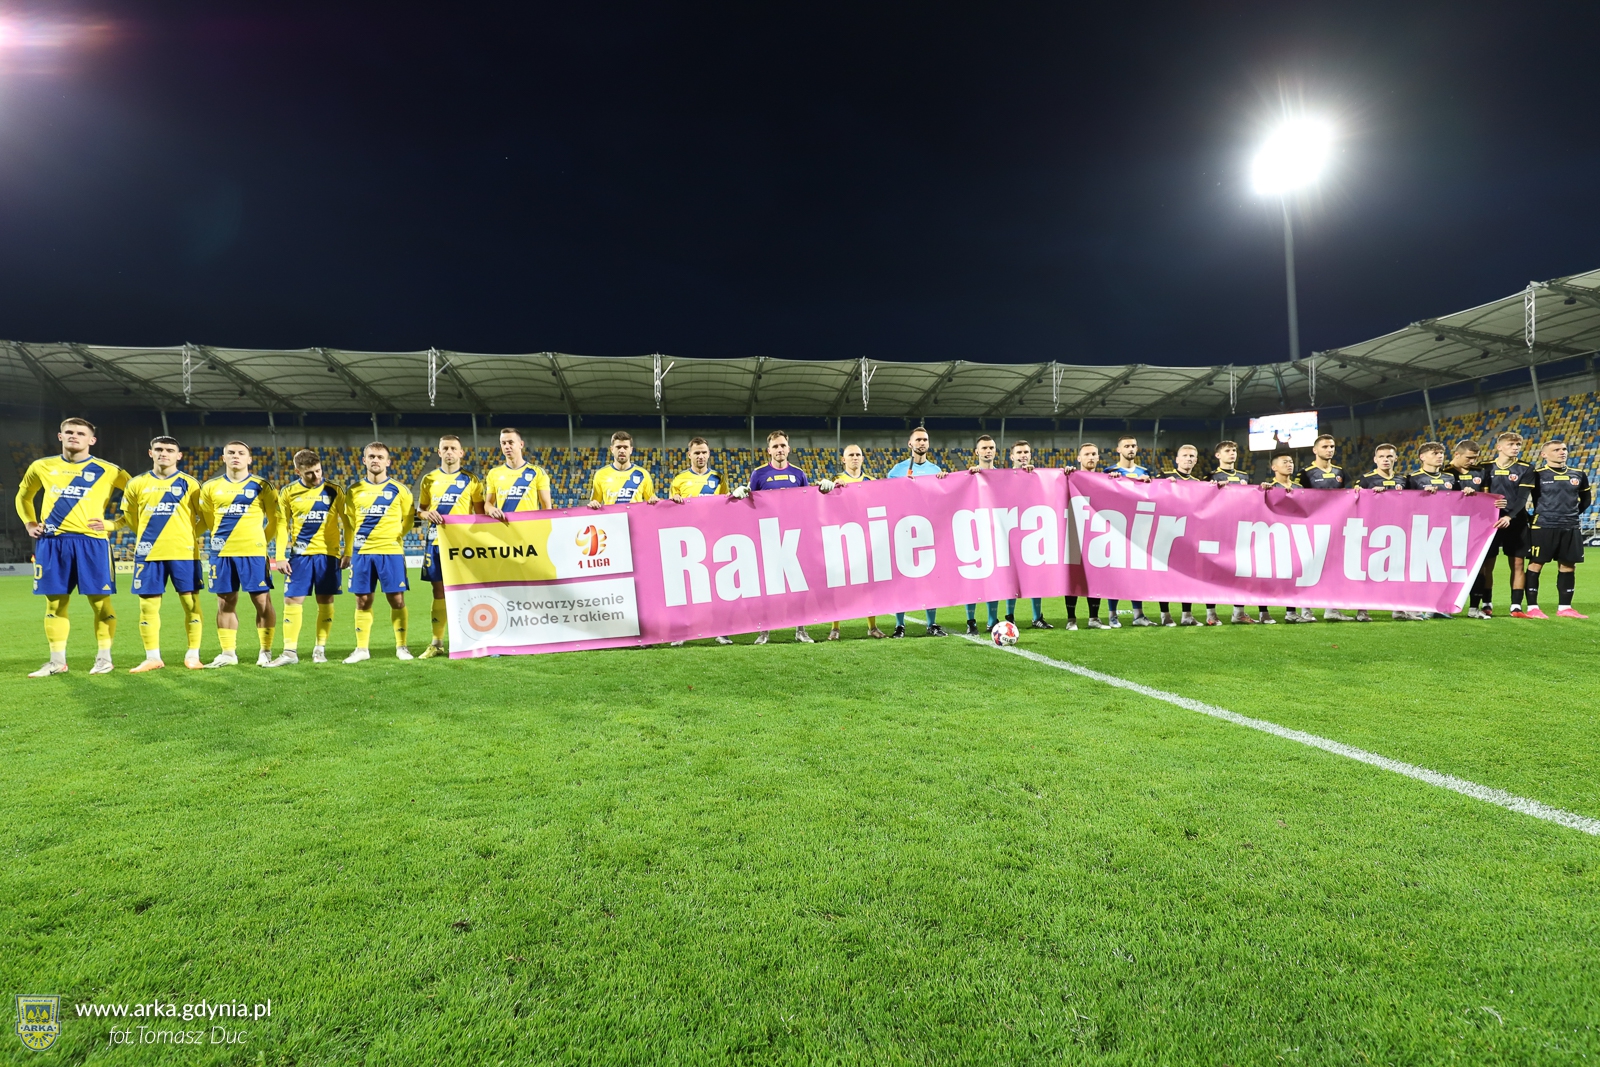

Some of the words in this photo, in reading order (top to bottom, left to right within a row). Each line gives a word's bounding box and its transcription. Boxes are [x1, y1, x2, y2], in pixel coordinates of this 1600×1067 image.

[448, 544, 538, 561] FORTUNA
[658, 517, 809, 607] Rak
[821, 506, 936, 588] nie
[952, 505, 1058, 580] gra
[1064, 496, 1186, 571] fair
[1234, 520, 1331, 587] my
[1343, 514, 1470, 583] tak!
[1531, 546, 1540, 557] 11
[135, 563, 144, 578] 7
[577, 560, 584, 569] 1
[587, 557, 611, 568] LIGA
[506, 593, 624, 612] Stowarzyszenie
[510, 612, 559, 628] Młode
[563, 615, 570, 623] z
[574, 609, 625, 623] rakiem
